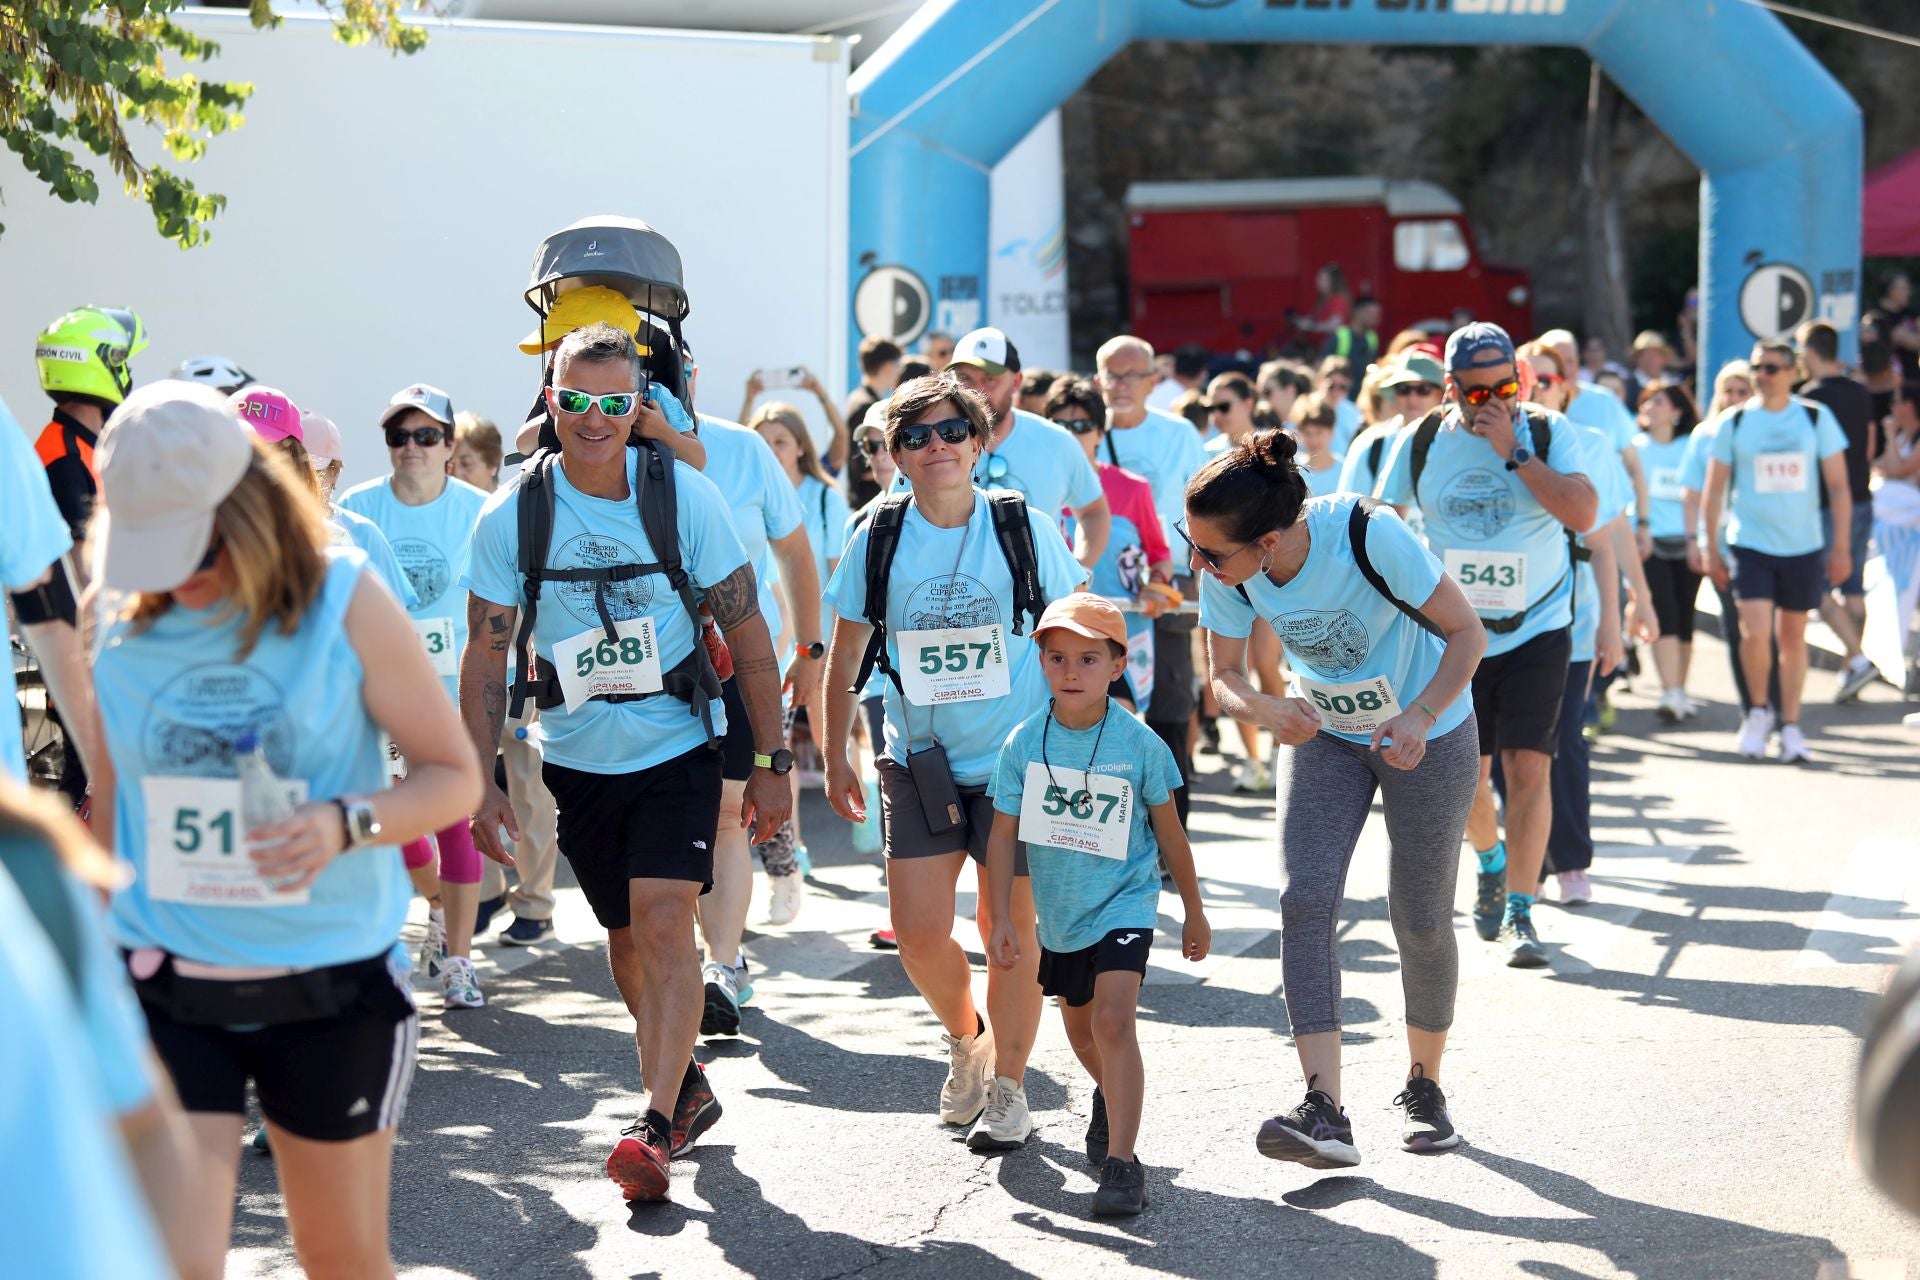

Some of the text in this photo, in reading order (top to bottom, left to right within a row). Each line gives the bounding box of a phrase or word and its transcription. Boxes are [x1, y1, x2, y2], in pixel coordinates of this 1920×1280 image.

[60, 350, 82, 360] CIVIL
[1460, 564, 1516, 588] 543
[930, 586, 968, 596] CIPRANO
[1282, 620, 1322, 632] CIPRIANO
[642, 622, 653, 658] MARCHA
[992, 628, 1002, 664] MARCHA
[576, 637, 644, 678] 568
[920, 642, 992, 674] 557
[934, 688, 982, 698] CIPRIANO
[1310, 688, 1382, 714] 508
[1375, 680, 1392, 704] MARCHA
[1042, 785, 1120, 824] 567
[1118, 785, 1129, 823] MARCHA
[174, 807, 234, 855] 51
[1050, 834, 1098, 848] CIPRIANO
